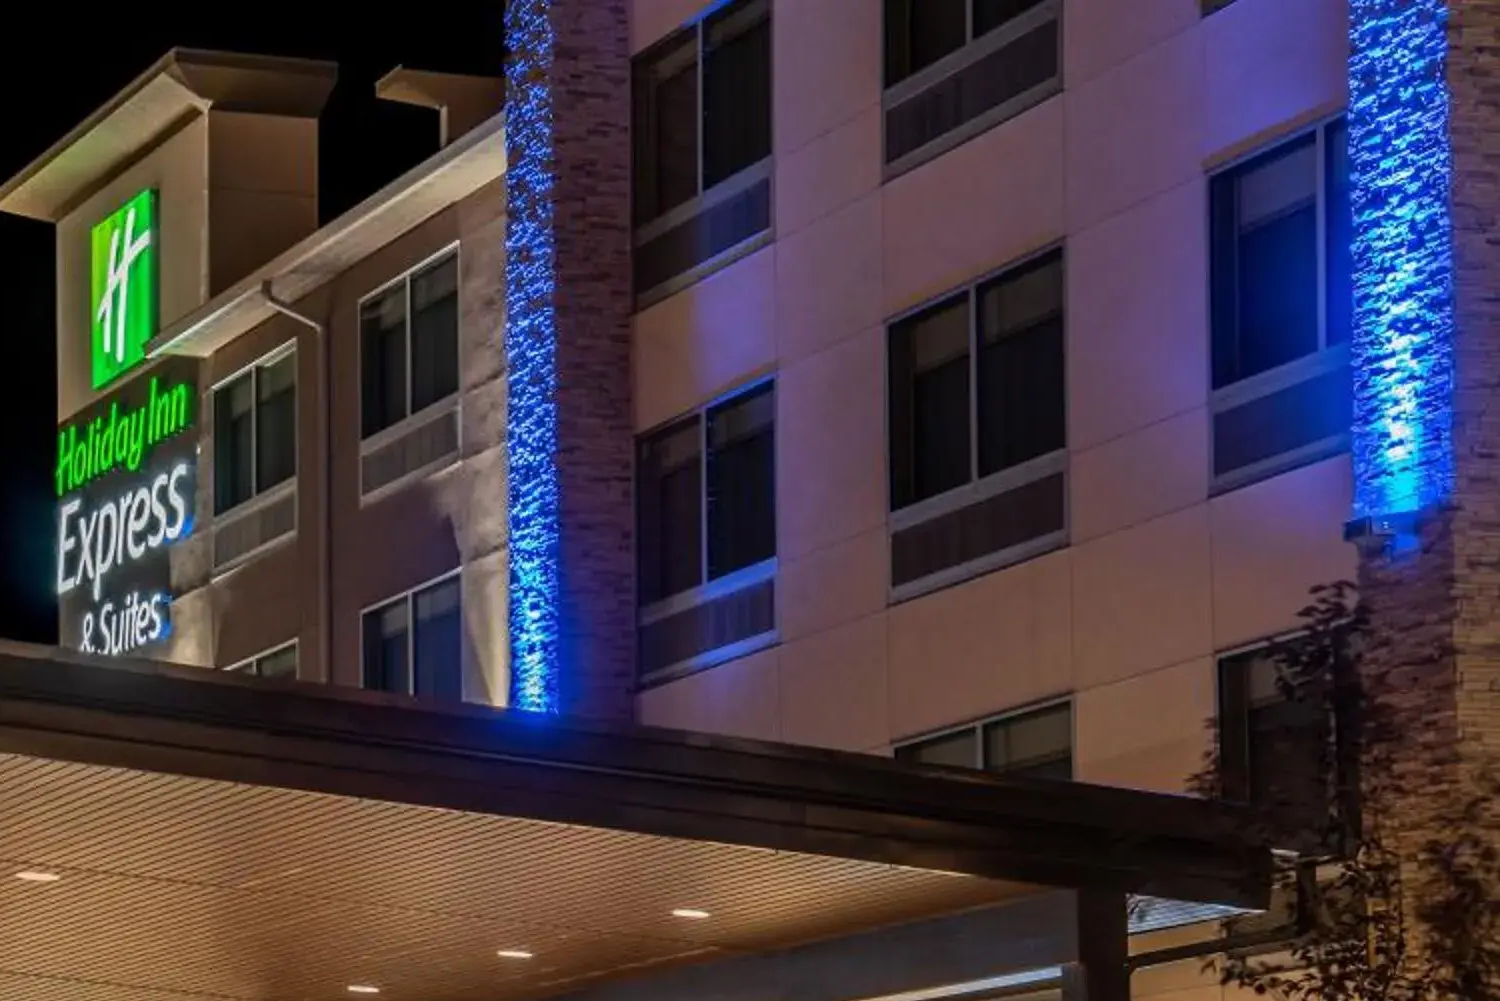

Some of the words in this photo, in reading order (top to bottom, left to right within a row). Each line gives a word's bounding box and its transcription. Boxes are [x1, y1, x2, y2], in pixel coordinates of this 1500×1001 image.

[56, 402, 145, 496] Holiday
[148, 376, 186, 445] Inn
[57, 463, 187, 602] Express
[79, 612, 96, 652] &
[98, 591, 161, 656] Suites
